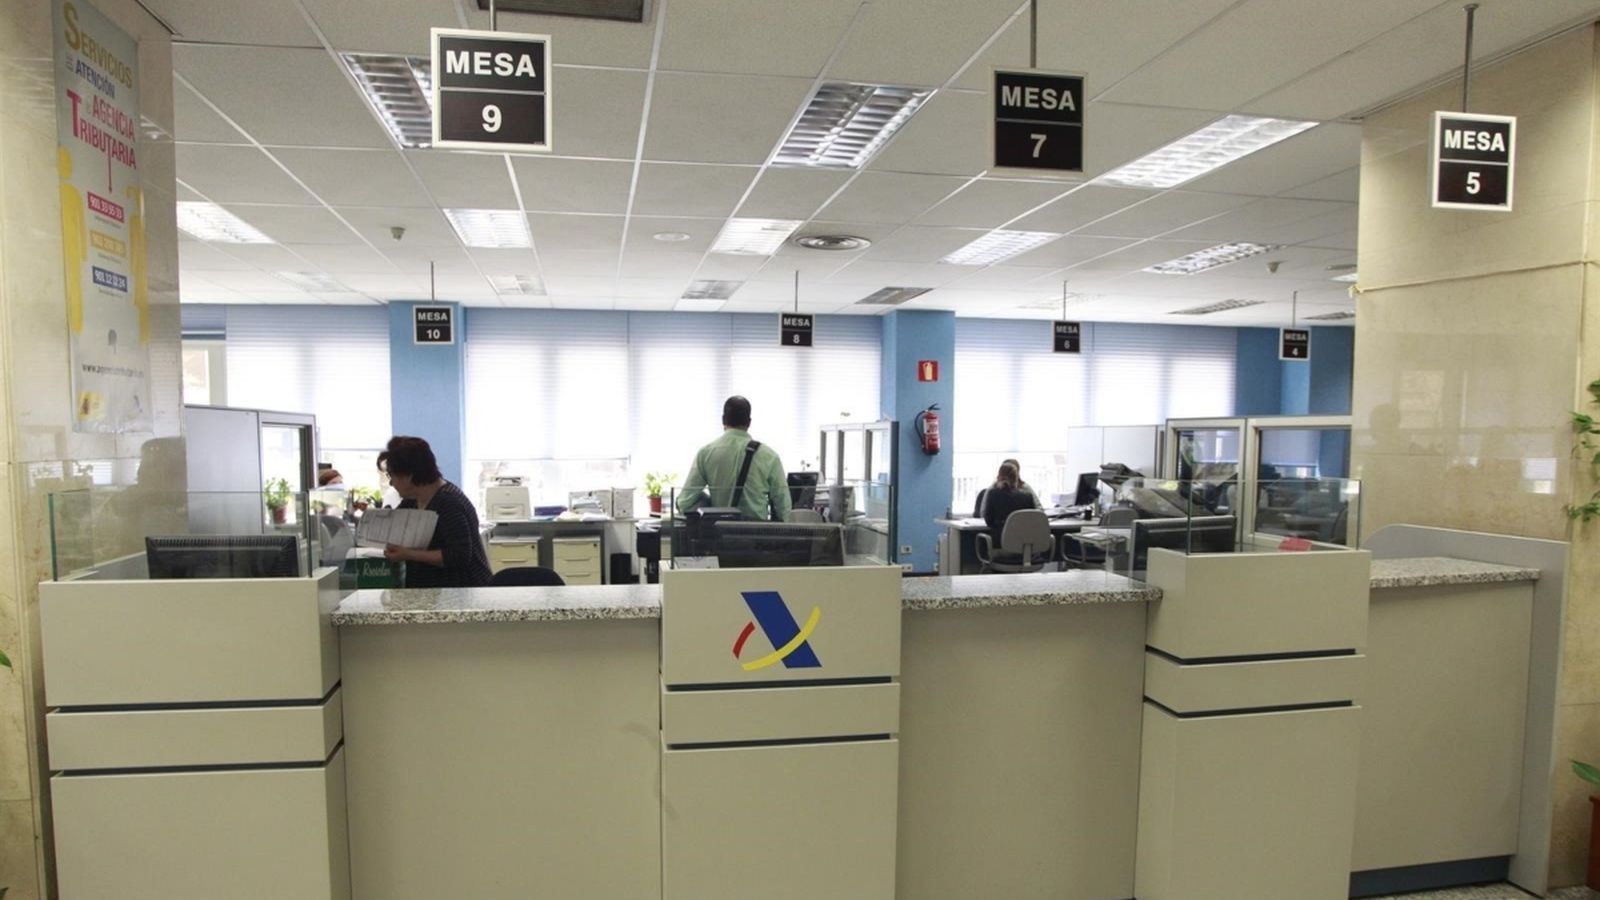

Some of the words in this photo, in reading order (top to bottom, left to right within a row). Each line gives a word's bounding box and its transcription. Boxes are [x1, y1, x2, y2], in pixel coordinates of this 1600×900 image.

[64, 2, 132, 89] SERVICIOS
[446, 50, 536, 77] MESA
[75, 58, 115, 99] ATENCIÓN
[1002, 85, 1076, 111] MESA
[66, 88, 137, 170] TRIBUTARIA
[92, 95, 136, 143] AGENCIA
[481, 104, 502, 133] 9
[1030, 133, 1048, 158] 7
[1445, 129, 1505, 152] MESA
[1466, 171, 1481, 195] 5
[417, 311, 448, 321] MESA
[783, 317, 810, 327] MESA
[426, 329, 441, 339] 10
[793, 334, 801, 344] 8
[1056, 325, 1078, 334] MESA
